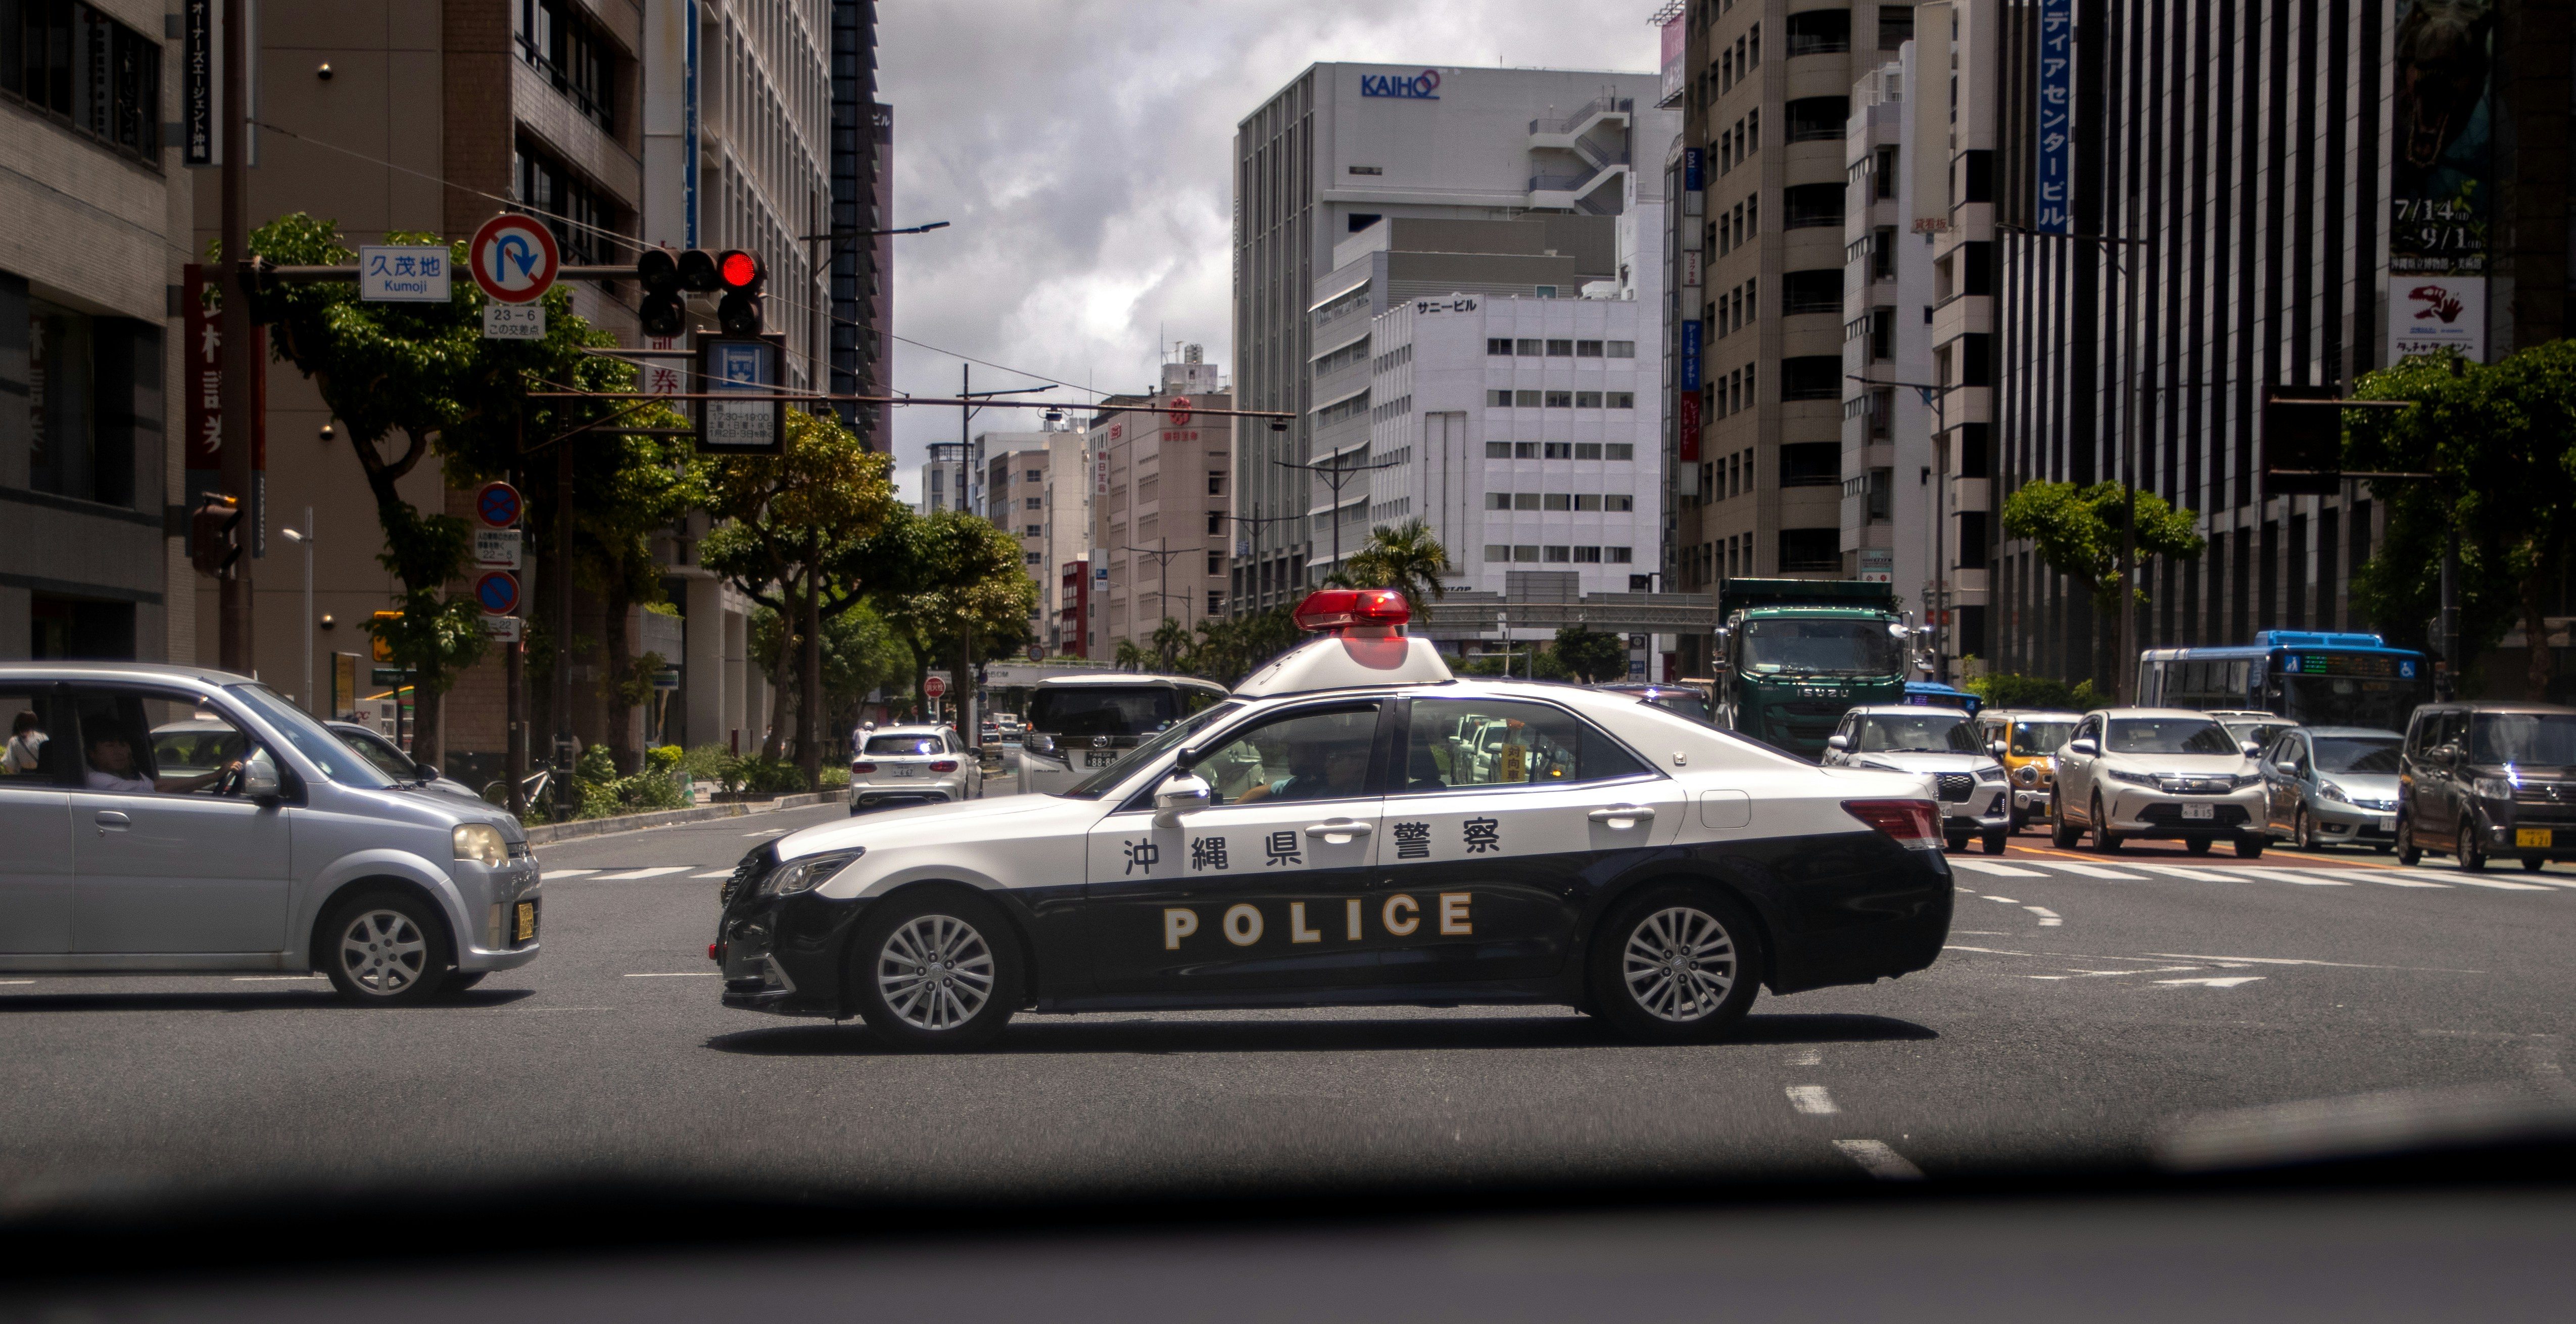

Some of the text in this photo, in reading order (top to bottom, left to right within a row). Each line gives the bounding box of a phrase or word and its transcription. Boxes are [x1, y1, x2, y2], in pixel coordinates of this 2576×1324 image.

[192, 2, 207, 159] オーナーズエージェント沖縄
[1362, 74, 1431, 98] KAIHO
[2040, 0, 2070, 226] ディアセンタービル
[1915, 218, 1946, 229] 貸看板
[370, 255, 441, 277] 久茂地
[385, 280, 427, 294] Kumoji
[1417, 299, 1477, 314] サニービル
[489, 324, 540, 336] この交差点
[1797, 688, 1850, 698] ISUZU
[1123, 816, 1500, 875] 沖縄県 警察
[1164, 892, 1473, 950] POLICE
